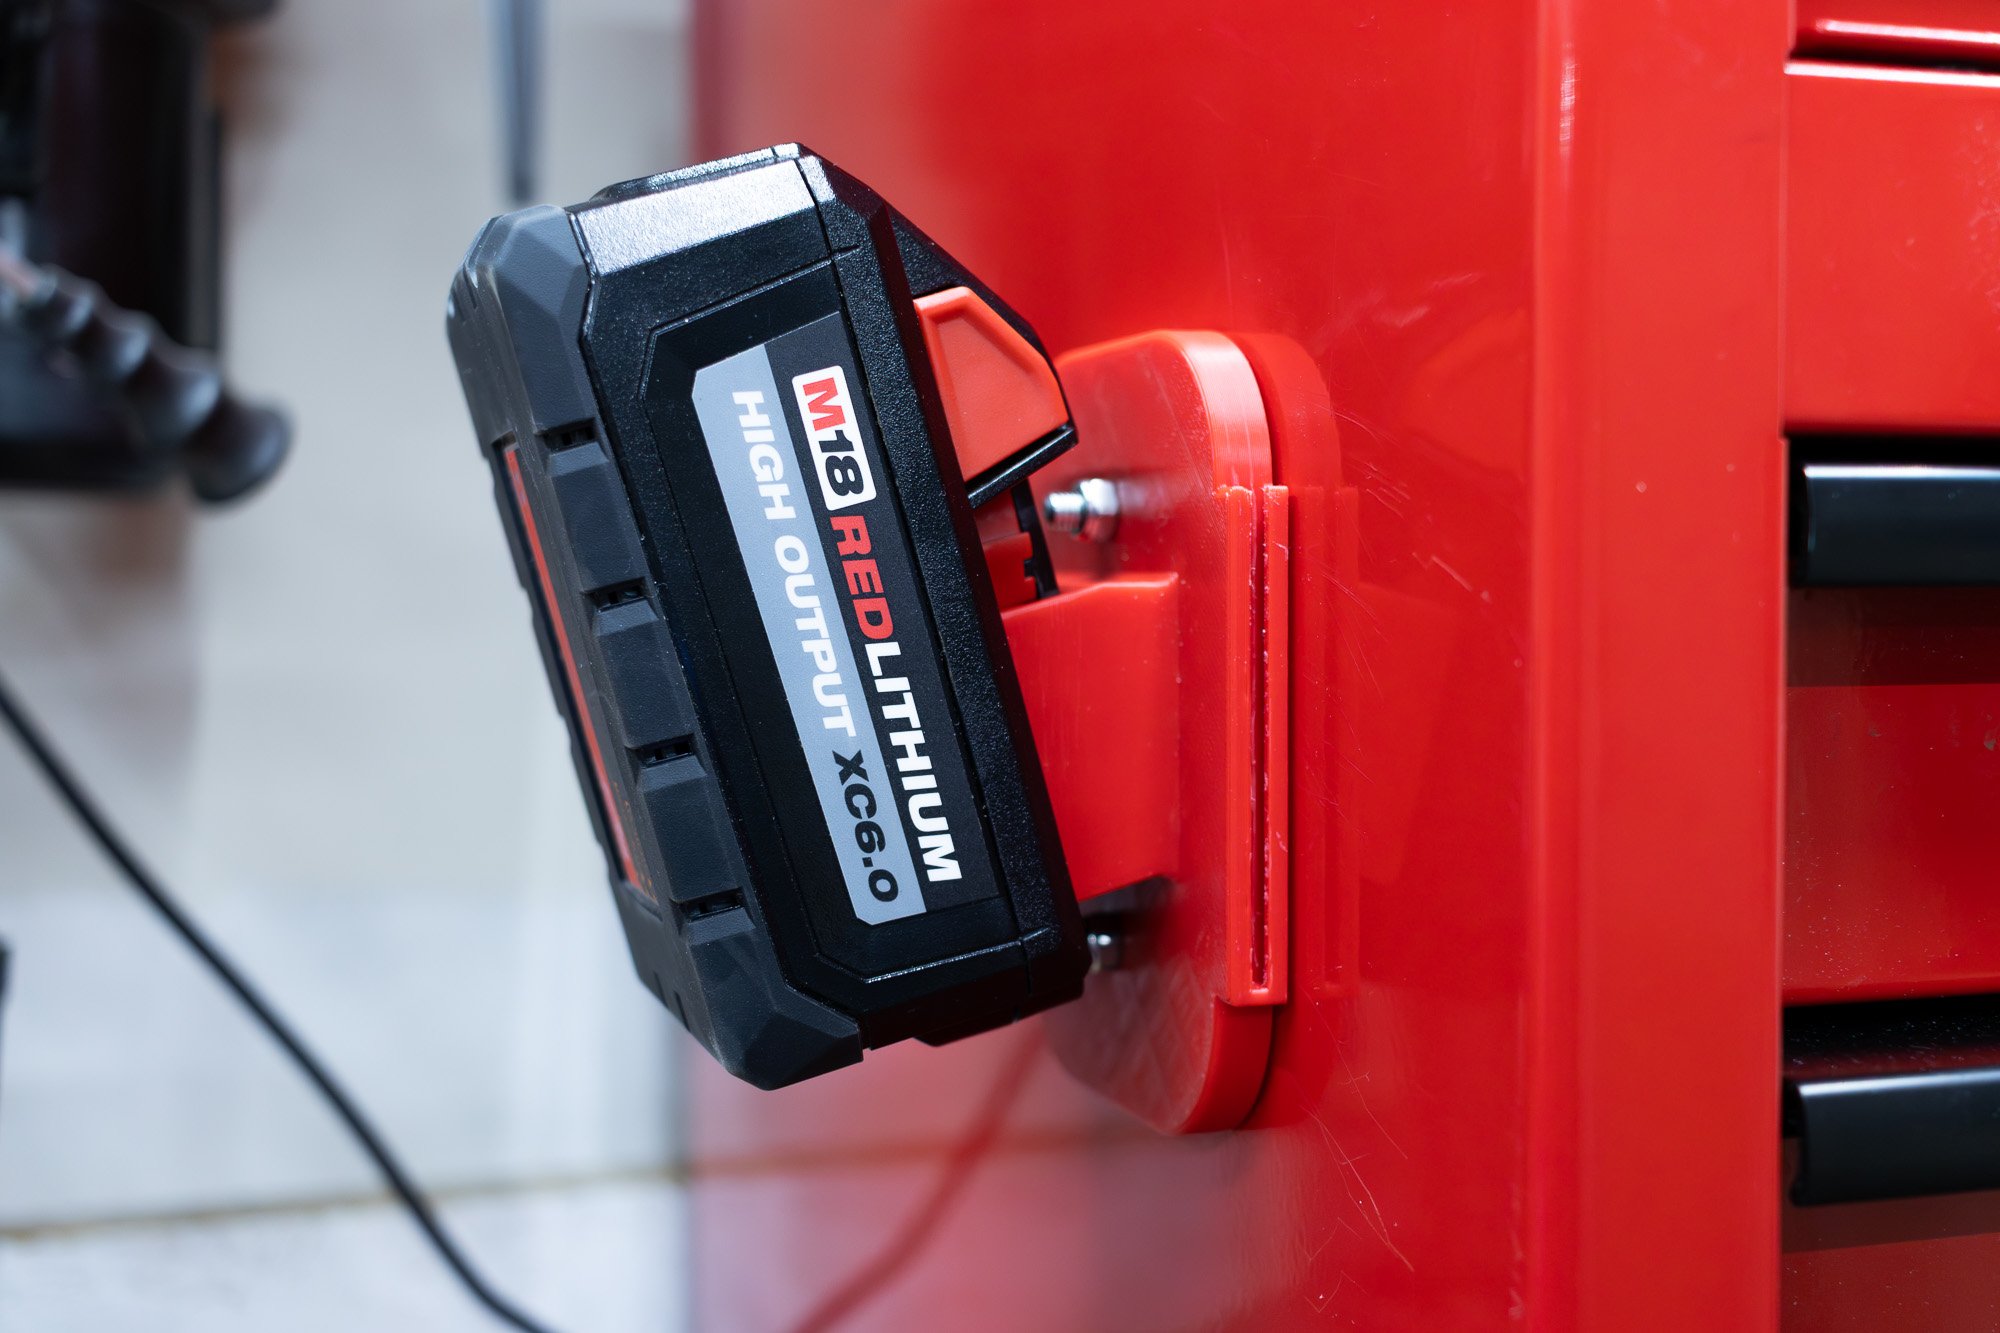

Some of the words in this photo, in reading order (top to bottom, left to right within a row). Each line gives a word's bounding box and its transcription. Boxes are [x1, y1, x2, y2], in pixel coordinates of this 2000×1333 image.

[802, 377, 864, 497] M18
[732, 390, 796, 520] HIGH
[774, 534, 857, 737] OUTPUT
[832, 749, 899, 902] XC6.0
[829, 515, 962, 882] REDLITHIUM
